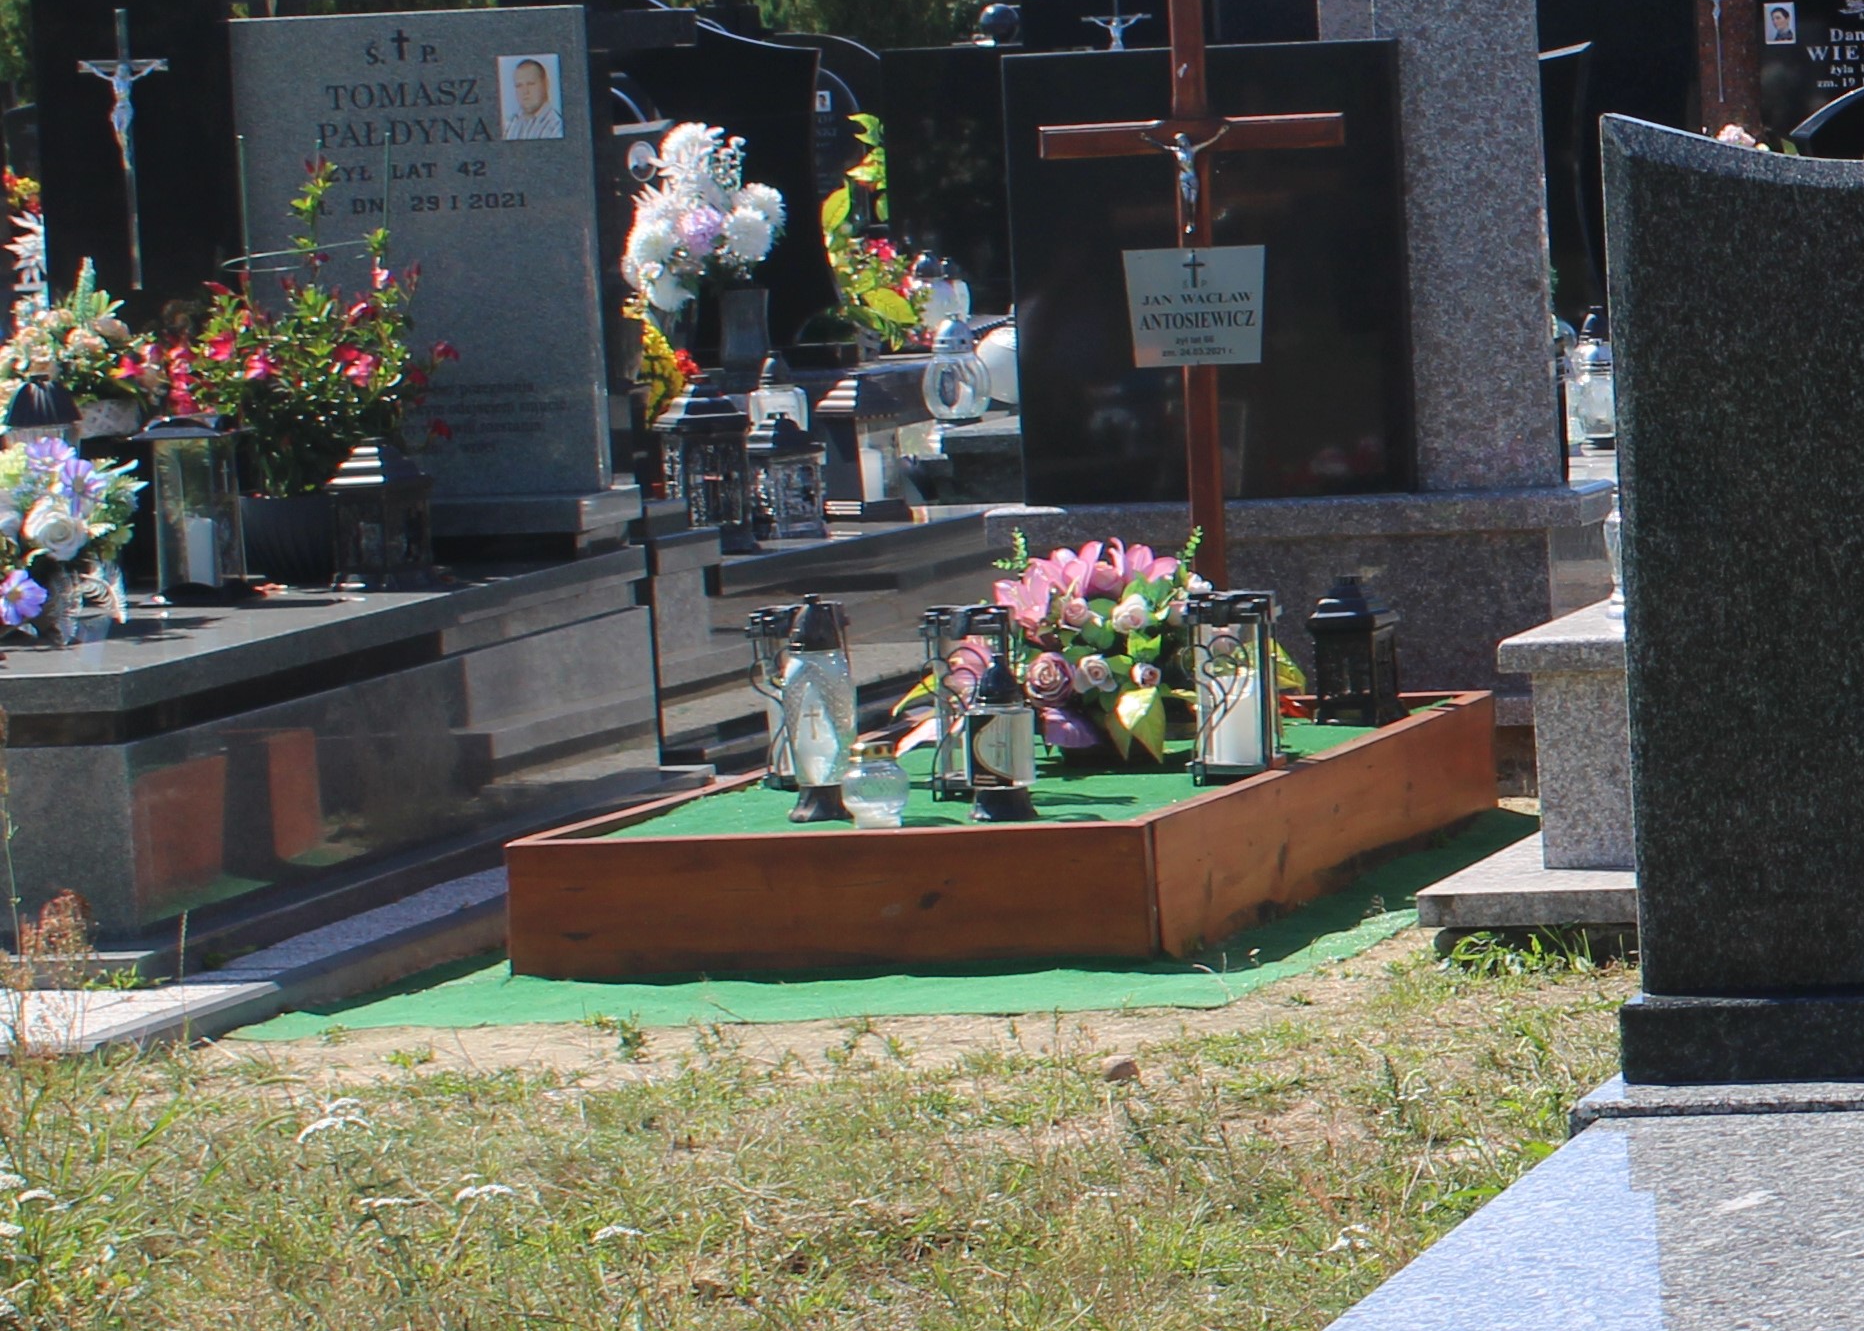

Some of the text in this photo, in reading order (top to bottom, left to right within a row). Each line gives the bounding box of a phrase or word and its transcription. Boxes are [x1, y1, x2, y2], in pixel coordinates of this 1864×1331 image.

[325, 79, 480, 111] TOMASZ
[317, 117, 496, 149] PAŁDYNA
[391, 163, 437, 180] LAT
[457, 161, 487, 177] 42
[410, 195, 441, 212] 29
[469, 191, 527, 210] 2021
[1141, 294, 1173, 306] JAN
[1140, 310, 1256, 331] ANTOSIEWICZ
